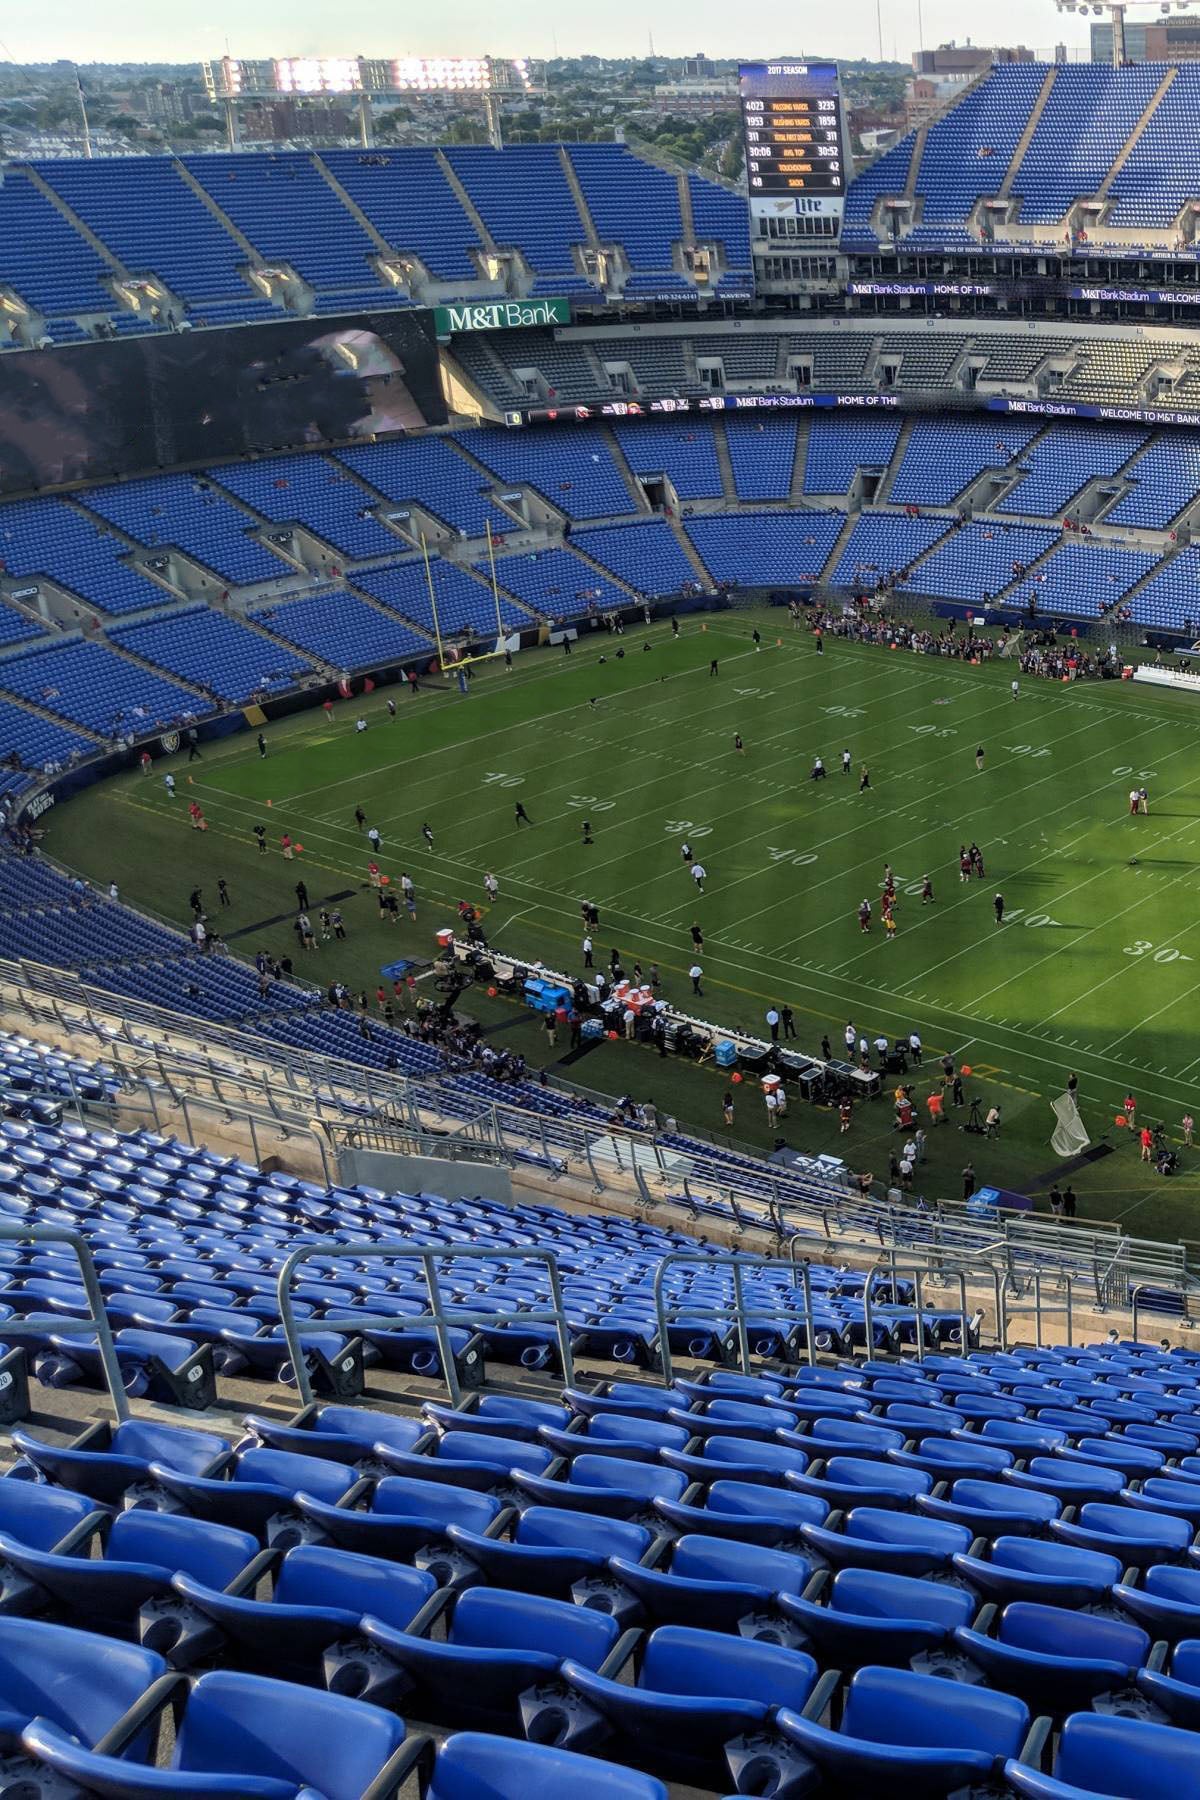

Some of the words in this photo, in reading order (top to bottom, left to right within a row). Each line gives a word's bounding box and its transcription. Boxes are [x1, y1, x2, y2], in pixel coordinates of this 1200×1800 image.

[767, 66, 782, 74] 2017
[783, 66, 808, 74] SEASON
[746, 101, 764, 110] 4023
[817, 101, 835, 110] 3235
[747, 117, 764, 126] 1953
[818, 116, 836, 126] 1856
[748, 132, 759, 141] 311
[826, 131, 837, 141] 311
[749, 147, 771, 156] 30:06
[818, 147, 838, 156] 30:52
[750, 162, 759, 172] 51
[829, 162, 840, 171] 42
[752, 177, 763, 187] 48
[832, 177, 840, 187] 41
[795, 198, 822, 216] Lite
[934, 285, 959, 294] HOME
[961, 285, 973, 294] OF
[1158, 293, 1200, 304] WELCOME
[447, 305, 504, 331] M&T
[866, 397, 879, 405] OF
[1100, 408, 1142, 420] WELCOME
[1144, 410, 1156, 420] TO
[1157, 412, 1175, 422] M&T
[1177, 413, 1200, 424] BANK
[1112, 766, 1158, 781] 50
[480, 772, 526, 788] 10
[566, 794, 617, 811] 20
[664, 820, 714, 838] 30
[766, 846, 818, 866] 40
[1122, 940, 1181, 963] 30
